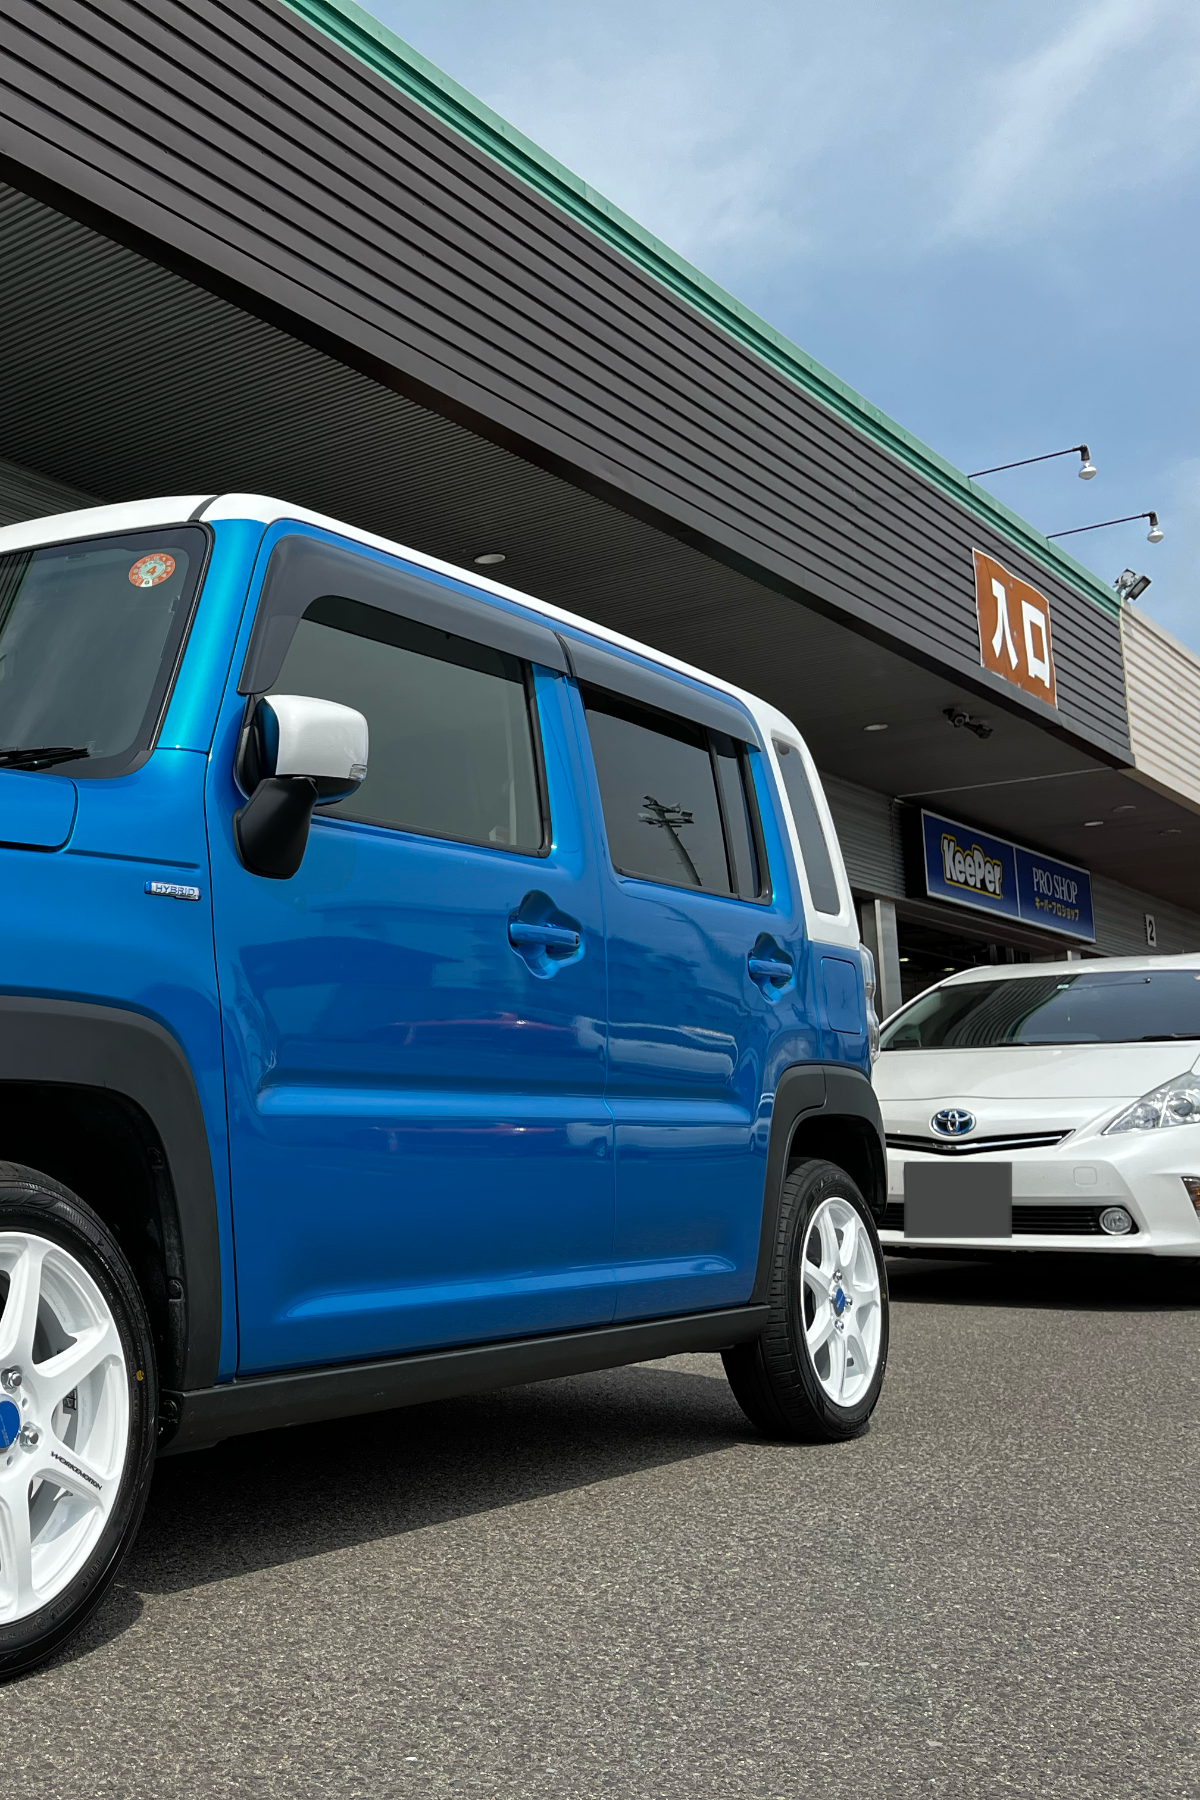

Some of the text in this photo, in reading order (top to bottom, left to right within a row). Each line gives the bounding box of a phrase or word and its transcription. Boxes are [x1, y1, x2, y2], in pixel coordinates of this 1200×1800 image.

[991, 577, 1051, 689] 入口
[942, 835, 1002, 897] KeePer
[1032, 866, 1078, 904] PRO SHOP
[155, 884, 196, 897] HYBRID
[1148, 919, 1155, 942] 2
